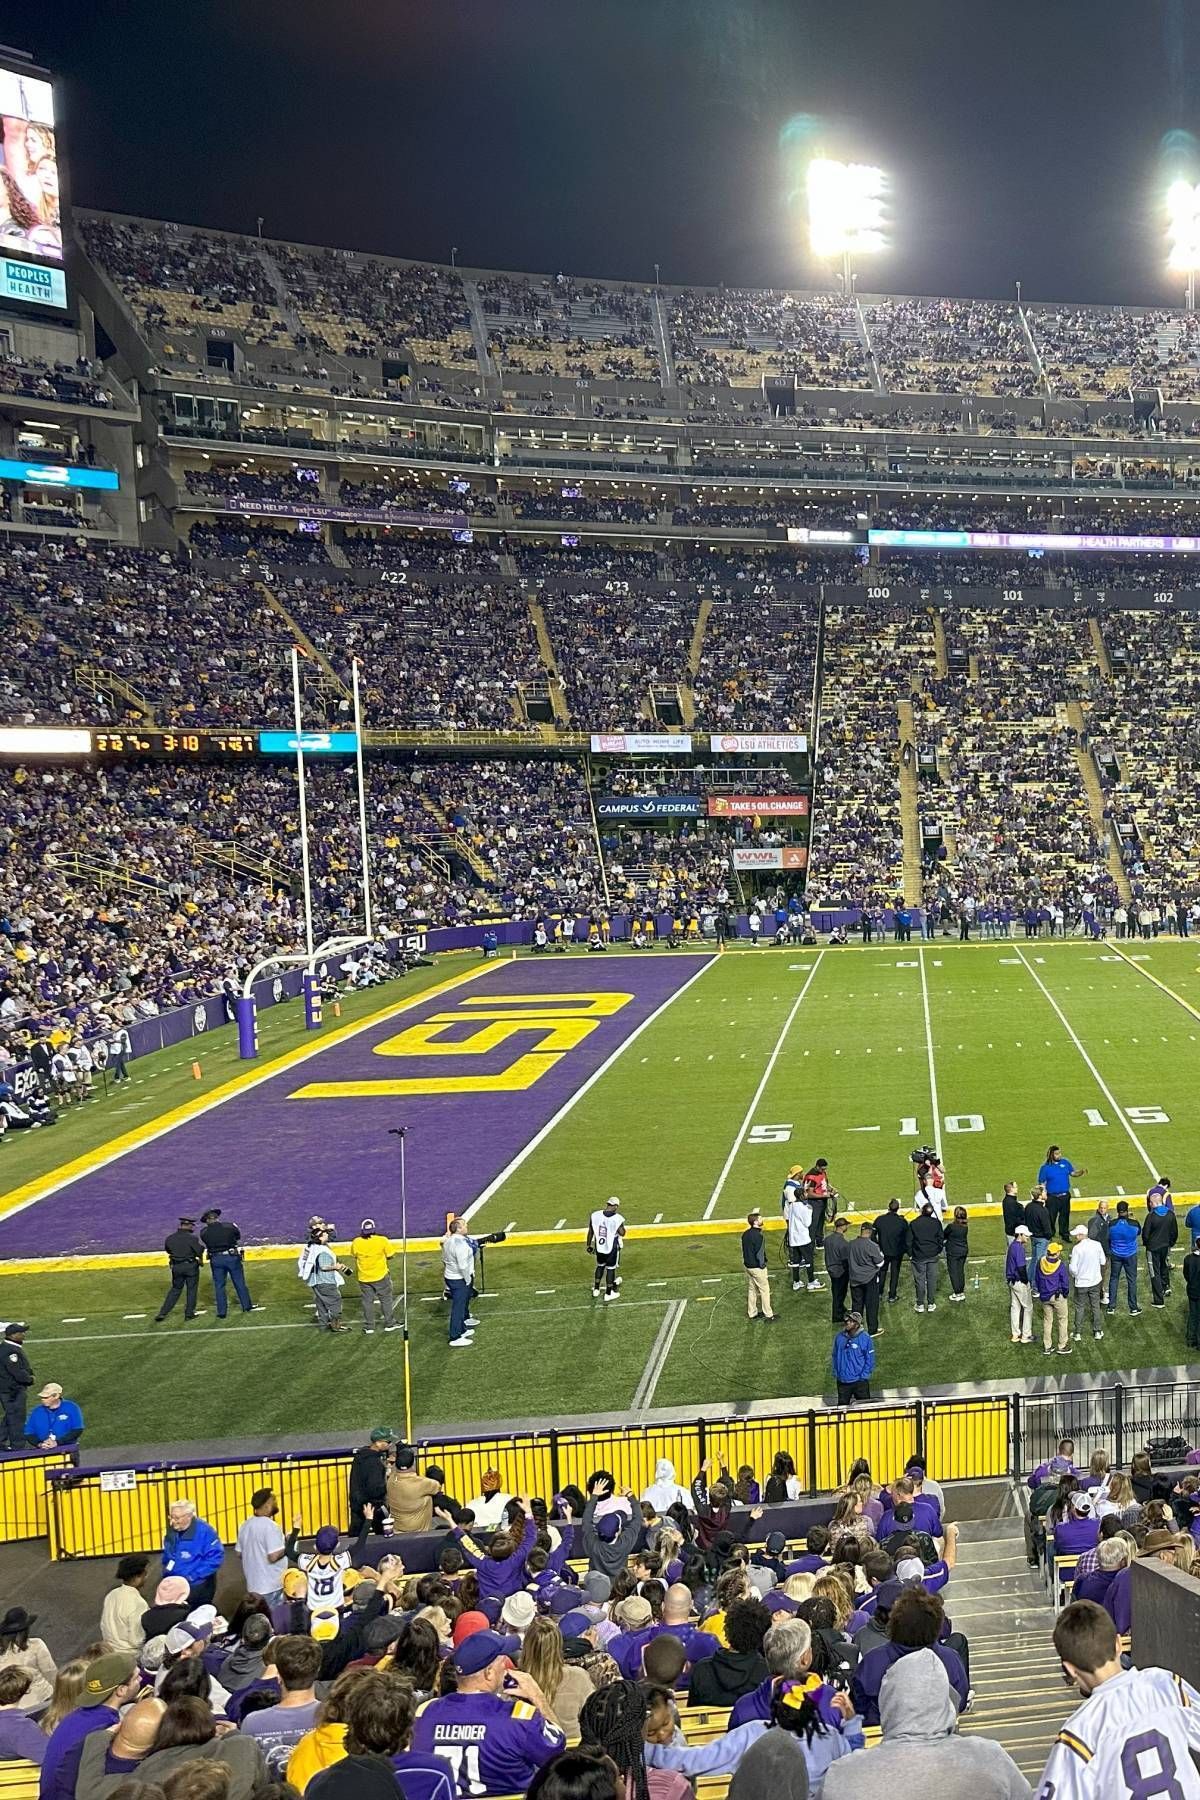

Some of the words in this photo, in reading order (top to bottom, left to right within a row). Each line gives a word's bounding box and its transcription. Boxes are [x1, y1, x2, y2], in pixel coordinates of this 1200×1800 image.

[8, 265, 50, 283] PEOPLES
[10, 281, 51, 298] HEALTH
[211, 328, 226, 337] 610
[387, 350, 401, 358] 611
[575, 380, 589, 388] 612
[239, 502, 261, 511] NEED
[263, 504, 289, 513] HELP?
[1082, 537, 1116, 547] HEALTH
[1118, 538, 1164, 549] PARTNERS
[867, 587, 890, 599] 100
[1003, 590, 1023, 601] 101
[1153, 592, 1174, 603] 102
[163, 736, 199, 750] 3:18
[673, 737, 684, 745] LIFE
[740, 740, 755, 750] LSU
[757, 740, 800, 750] ATHLETICS
[598, 805, 639, 813] CAMPUS
[657, 804, 696, 812] FEDERAL
[730, 802, 750, 810] TAKE
[757, 802, 771, 810] OIL
[771, 802, 803, 810] CHANGE
[736, 852, 777, 860] WWL
[399, 934, 426, 951] LSU
[310, 980, 323, 1024] LSU
[286, 993, 635, 1099] LSU
[1082, 1105, 1171, 1125] 15
[897, 1114, 986, 1135] 10
[747, 1123, 795, 1143] 5
[313, 1577, 334, 1596] 18
[434, 1724, 486, 1740] ELLENDER
[433, 1745, 488, 1795] 71
[1121, 1728, 1186, 1800] 8
